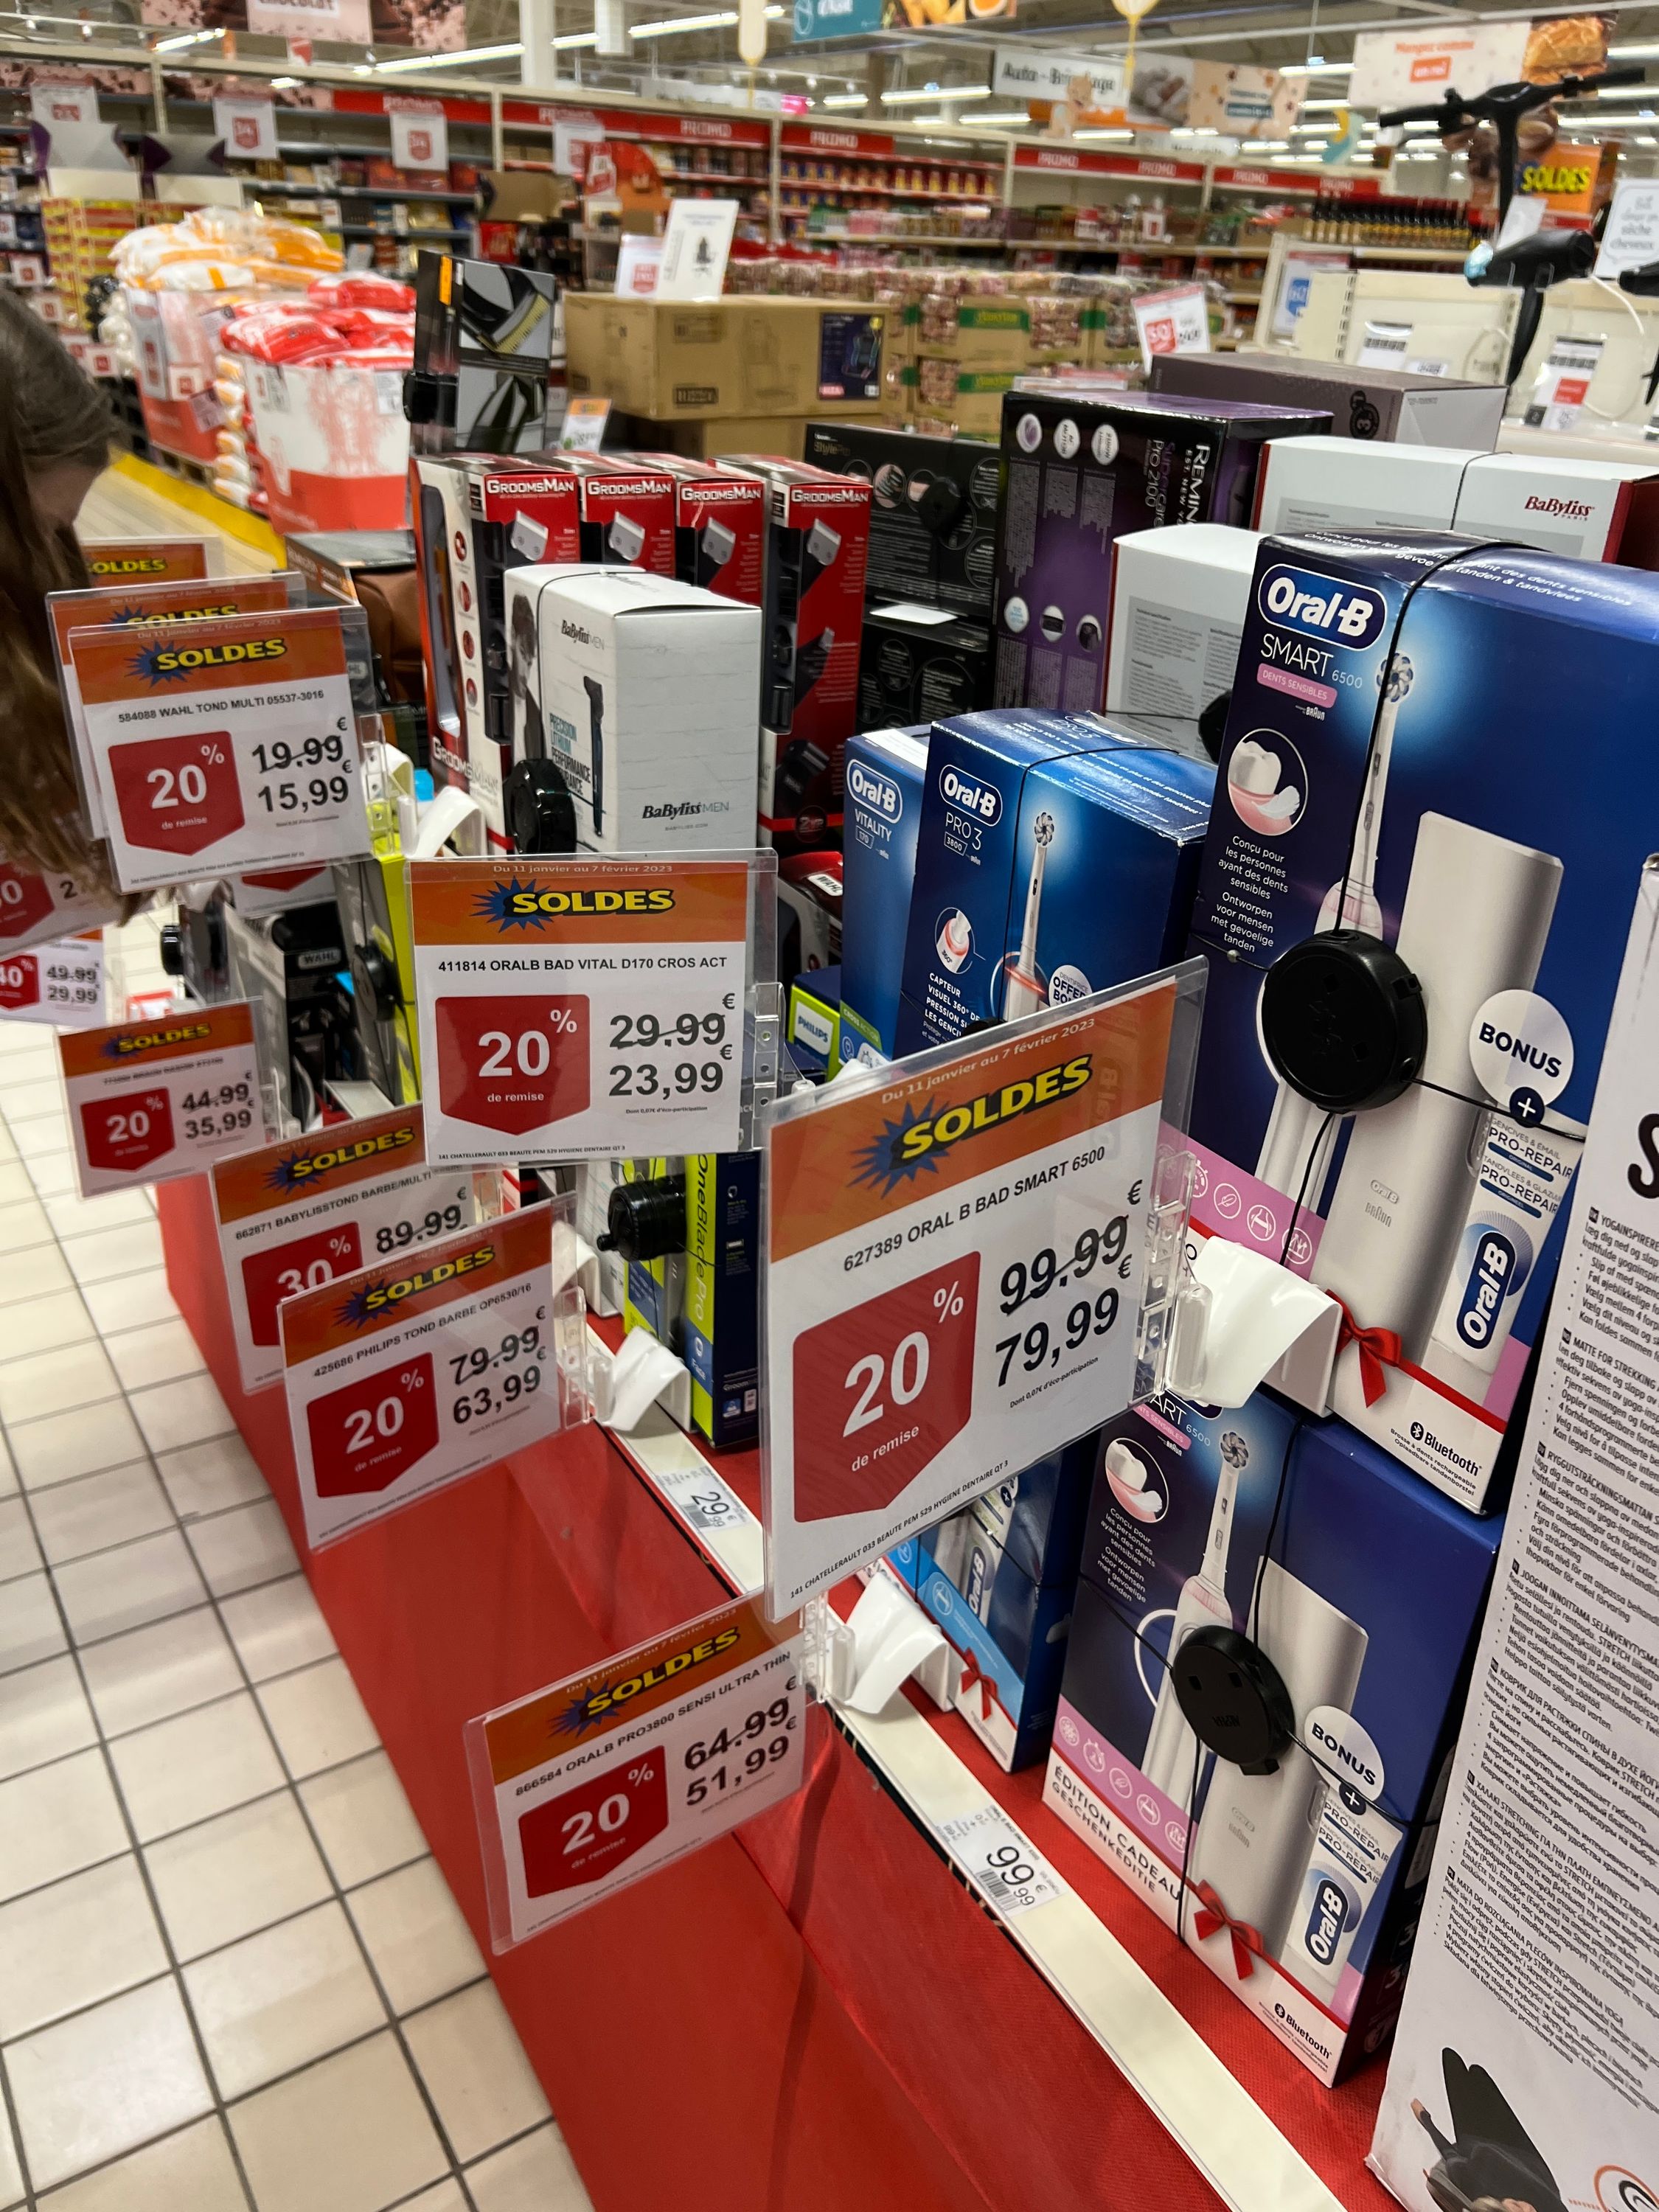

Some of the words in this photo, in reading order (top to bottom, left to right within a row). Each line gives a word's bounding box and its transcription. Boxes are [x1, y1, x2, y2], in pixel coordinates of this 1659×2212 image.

[1522, 165, 1591, 193] SOLDES
[1145, 469, 1160, 507] 2100
[1525, 496, 1591, 516] BaByliss
[1267, 577, 1373, 636] Oral-B
[156, 639, 286, 669] SOLDES
[1261, 633, 1334, 677] SMART
[1332, 669, 1363, 689] 6500
[1262, 669, 1286, 685] DENTS
[1288, 679, 1327, 700] SENSIBLES
[119, 710, 156, 723] 584088
[159, 706, 193, 717] WAHL
[196, 701, 228, 713] TOND
[231, 698, 265, 709] MULTI
[251, 734, 344, 773] 19.99
[147, 764, 207, 810] 20
[258, 776, 349, 813] 15,99
[852, 767, 897, 813] Oral-B
[944, 771, 995, 818] Oral-B
[642, 802, 701, 820] BaByliss
[701, 801, 730, 813] MEN
[855, 808, 892, 842] VITALITY
[945, 813, 971, 838] PRO
[971, 827, 982, 850] 3
[947, 835, 963, 852] 3800
[1225, 846, 1238, 859] les
[1240, 854, 1286, 878] personnes
[1232, 835, 1260, 854] Conçu
[1262, 849, 1284, 863] pour
[1219, 859, 1242, 874] ayant
[1245, 869, 1260, 881] des
[1263, 877, 1288, 892] dents
[1231, 877, 1270, 900] sensibles
[513, 890, 674, 914] SOLDES
[1217, 904, 1237, 917] voor
[1239, 914, 1273, 933] mensen
[1222, 892, 1272, 919] Ontworpen
[1211, 915, 1228, 928] met
[1231, 924, 1273, 947] gevoelige
[1224, 933, 1255, 953] tanden
[439, 961, 486, 972] 411814
[490, 960, 540, 971] ORALB
[544, 960, 574, 970] BAD
[578, 959, 617, 970] VITAL
[622, 958, 653, 969] D170
[657, 958, 695, 969] CROS
[700, 958, 727, 967] ACT
[930, 973, 960, 998] CAPTEUR
[925, 1009, 936, 1023] LES
[926, 997, 959, 1023] PRESSION
[928, 984, 950, 1005] VISUEL
[118, 1023, 211, 1054] SOLDES
[609, 1012, 726, 1049] 29.99
[798, 1016, 828, 1043] PHILIPS
[1479, 1022, 1562, 1077] BONUS
[478, 1030, 549, 1077] 20
[883, 1089, 902, 1104] Du
[908, 1082, 922, 1094] 11
[928, 1062, 977, 1091] janvier
[980, 1054, 998, 1068] au
[1003, 1048, 1010, 1059] 7
[1014, 1033, 1057, 1054] février
[1062, 1018, 1095, 1037] 2023
[182, 1082, 248, 1113] 44.99
[608, 1062, 723, 1100] 23,99
[106, 1110, 150, 1144] 20
[185, 1109, 251, 1139] 35,99
[902, 1056, 1090, 1159] SOLDES
[293, 1128, 415, 1179] SOLDES
[1489, 1127, 1572, 1178] PRO-REPAIR
[275, 1193, 358, 1227] BABYLISSTOND
[361, 1172, 431, 1199] BARBE/MULTI
[844, 1234, 902, 1271] 627389
[908, 1212, 953, 1242] ORAL
[960, 1203, 970, 1220] B
[975, 1186, 1009, 1214] BAD
[1014, 1161, 1068, 1197] SMART
[1072, 1146, 1105, 1171] 6500
[375, 1204, 462, 1253] 89.99
[366, 1245, 495, 1310] SOLDES
[999, 1215, 1129, 1316] 99.99
[1464, 1242, 1508, 1340] Oral-B
[314, 1355, 353, 1377] 425686
[357, 1335, 401, 1360] PHILIPS
[404, 1321, 436, 1340] TOND
[439, 1305, 477, 1327] BARBE
[450, 1326, 539, 1385] 79.99
[995, 1287, 1119, 1388] 79,99
[1571, 1352, 1584, 1366] deg
[843, 1332, 929, 1438] 20
[1573, 1338, 1596, 1357] MATTE
[1598, 1351, 1613, 1366] FOR
[1614, 1360, 1656, 1389] STREKKING
[453, 1366, 540, 1424] 63,99
[1010, 1393, 1025, 1408] Dont
[1026, 1385, 1043, 1399] 0,07€
[344, 1397, 404, 1454] 20
[1186, 1425, 1211, 1446] 6500
[852, 1455, 869, 1472] de
[873, 1425, 919, 1460] remise
[1391, 1428, 1410, 1444] Brosse
[1416, 1447, 1433, 1461] dents
[1435, 1460, 1476, 1489] rechargeable
[1395, 1439, 1429, 1465] Oplaadbare
[1430, 1464, 1474, 1495] tandenborstel
[1425, 1432, 1478, 1476] Bluetooth
[691, 1492, 729, 1514] 29
[790, 1586, 803, 1599] 141
[804, 1548, 861, 1590] CHATELLERAULT
[863, 1541, 875, 1552] 033
[877, 1523, 902, 1545] BEAUTE
[903, 1513, 919, 1527] PEM
[920, 1506, 932, 1518] 529
[933, 1488, 961, 1509] HYGIENE
[962, 1469, 993, 1492] DENTAIRE
[995, 1464, 1003, 1473] QT
[587, 1628, 738, 1716] SOLDES
[516, 1765, 561, 1796] 866584
[566, 1742, 614, 1771] ORALB
[617, 1712, 674, 1746] PRO3800
[678, 1691, 716, 1717] SENSI
[719, 1669, 759, 1694] ULTRA
[764, 1650, 790, 1672] THIN
[684, 1696, 790, 1770] 64.99
[686, 1736, 790, 1806] 51,99
[1312, 1722, 1376, 1785] BONUS
[561, 1793, 630, 1855] 20
[1052, 1782, 1155, 1892] GESCHENKEDITIE
[1055, 1766, 1110, 1830] ÉDITION
[1117, 1833, 1180, 1900] CADEAU
[987, 1846, 1034, 1885] 99
[1310, 1887, 1343, 1959] Oral-B
[1286, 2014, 1329, 2059] Bluetooth
